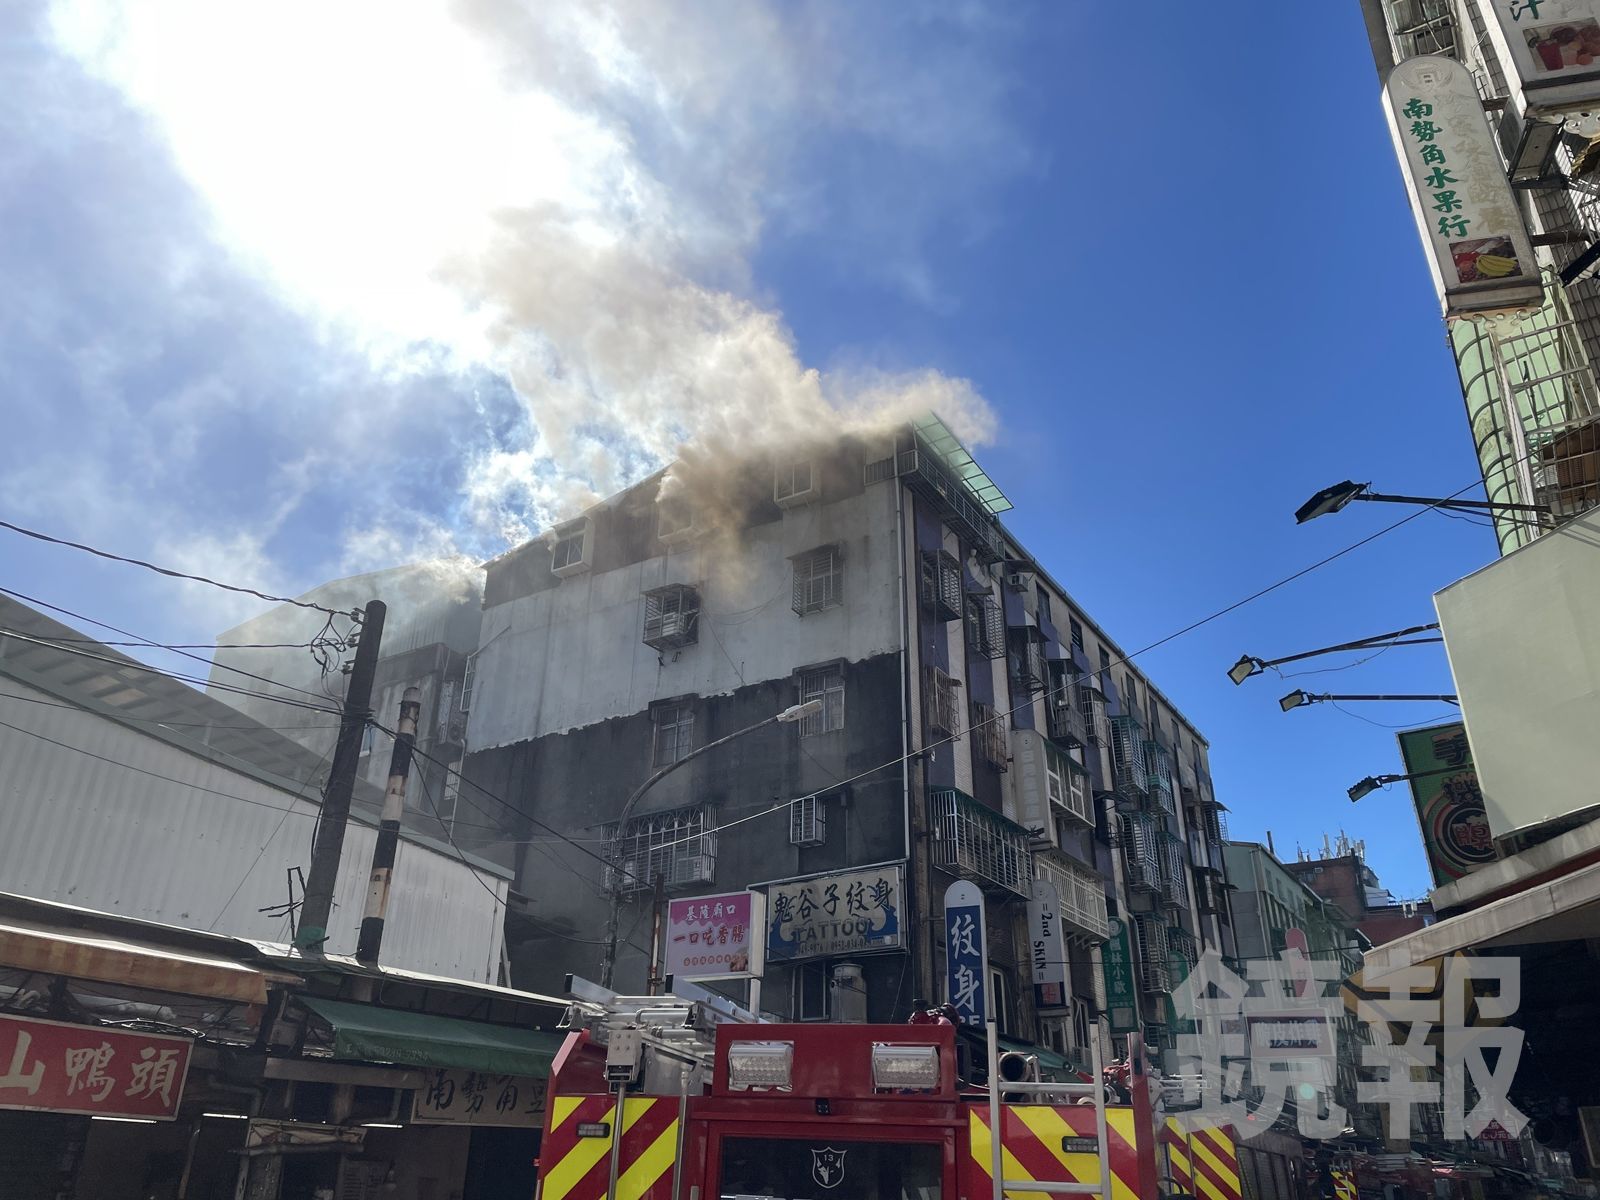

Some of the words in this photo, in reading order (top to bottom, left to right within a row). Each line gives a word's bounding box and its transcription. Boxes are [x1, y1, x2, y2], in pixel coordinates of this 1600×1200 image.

[1402, 97, 1471, 238] 南勢角水果行
[774, 877, 893, 923] 鬼谷子紋身
[673, 924, 745, 946] 一口吃香腸
[794, 917, 868, 942] TATTOO
[1041, 911, 1053, 938] 2nd
[950, 914, 981, 1013] 紋身
[1033, 940, 1047, 970] SKIN
[0, 1030, 179, 1107] 山鴨頭
[823, 1154, 834, 1162] 13
